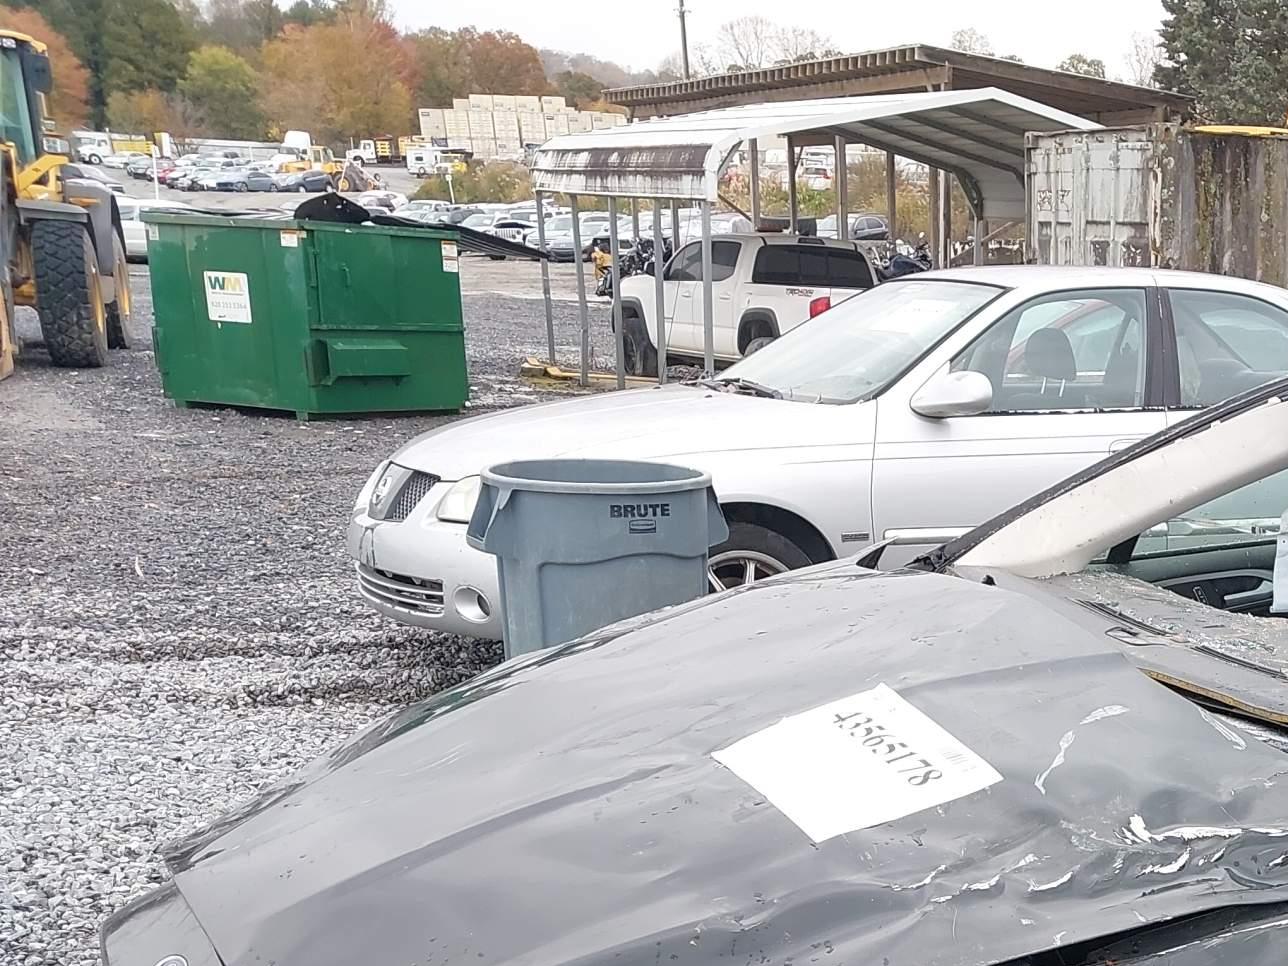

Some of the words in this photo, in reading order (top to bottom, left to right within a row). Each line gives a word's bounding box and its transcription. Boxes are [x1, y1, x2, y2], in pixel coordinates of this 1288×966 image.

[207, 275, 243, 292] WM
[609, 503, 671, 518] BRUTE
[831, 711, 944, 787] 43565178
